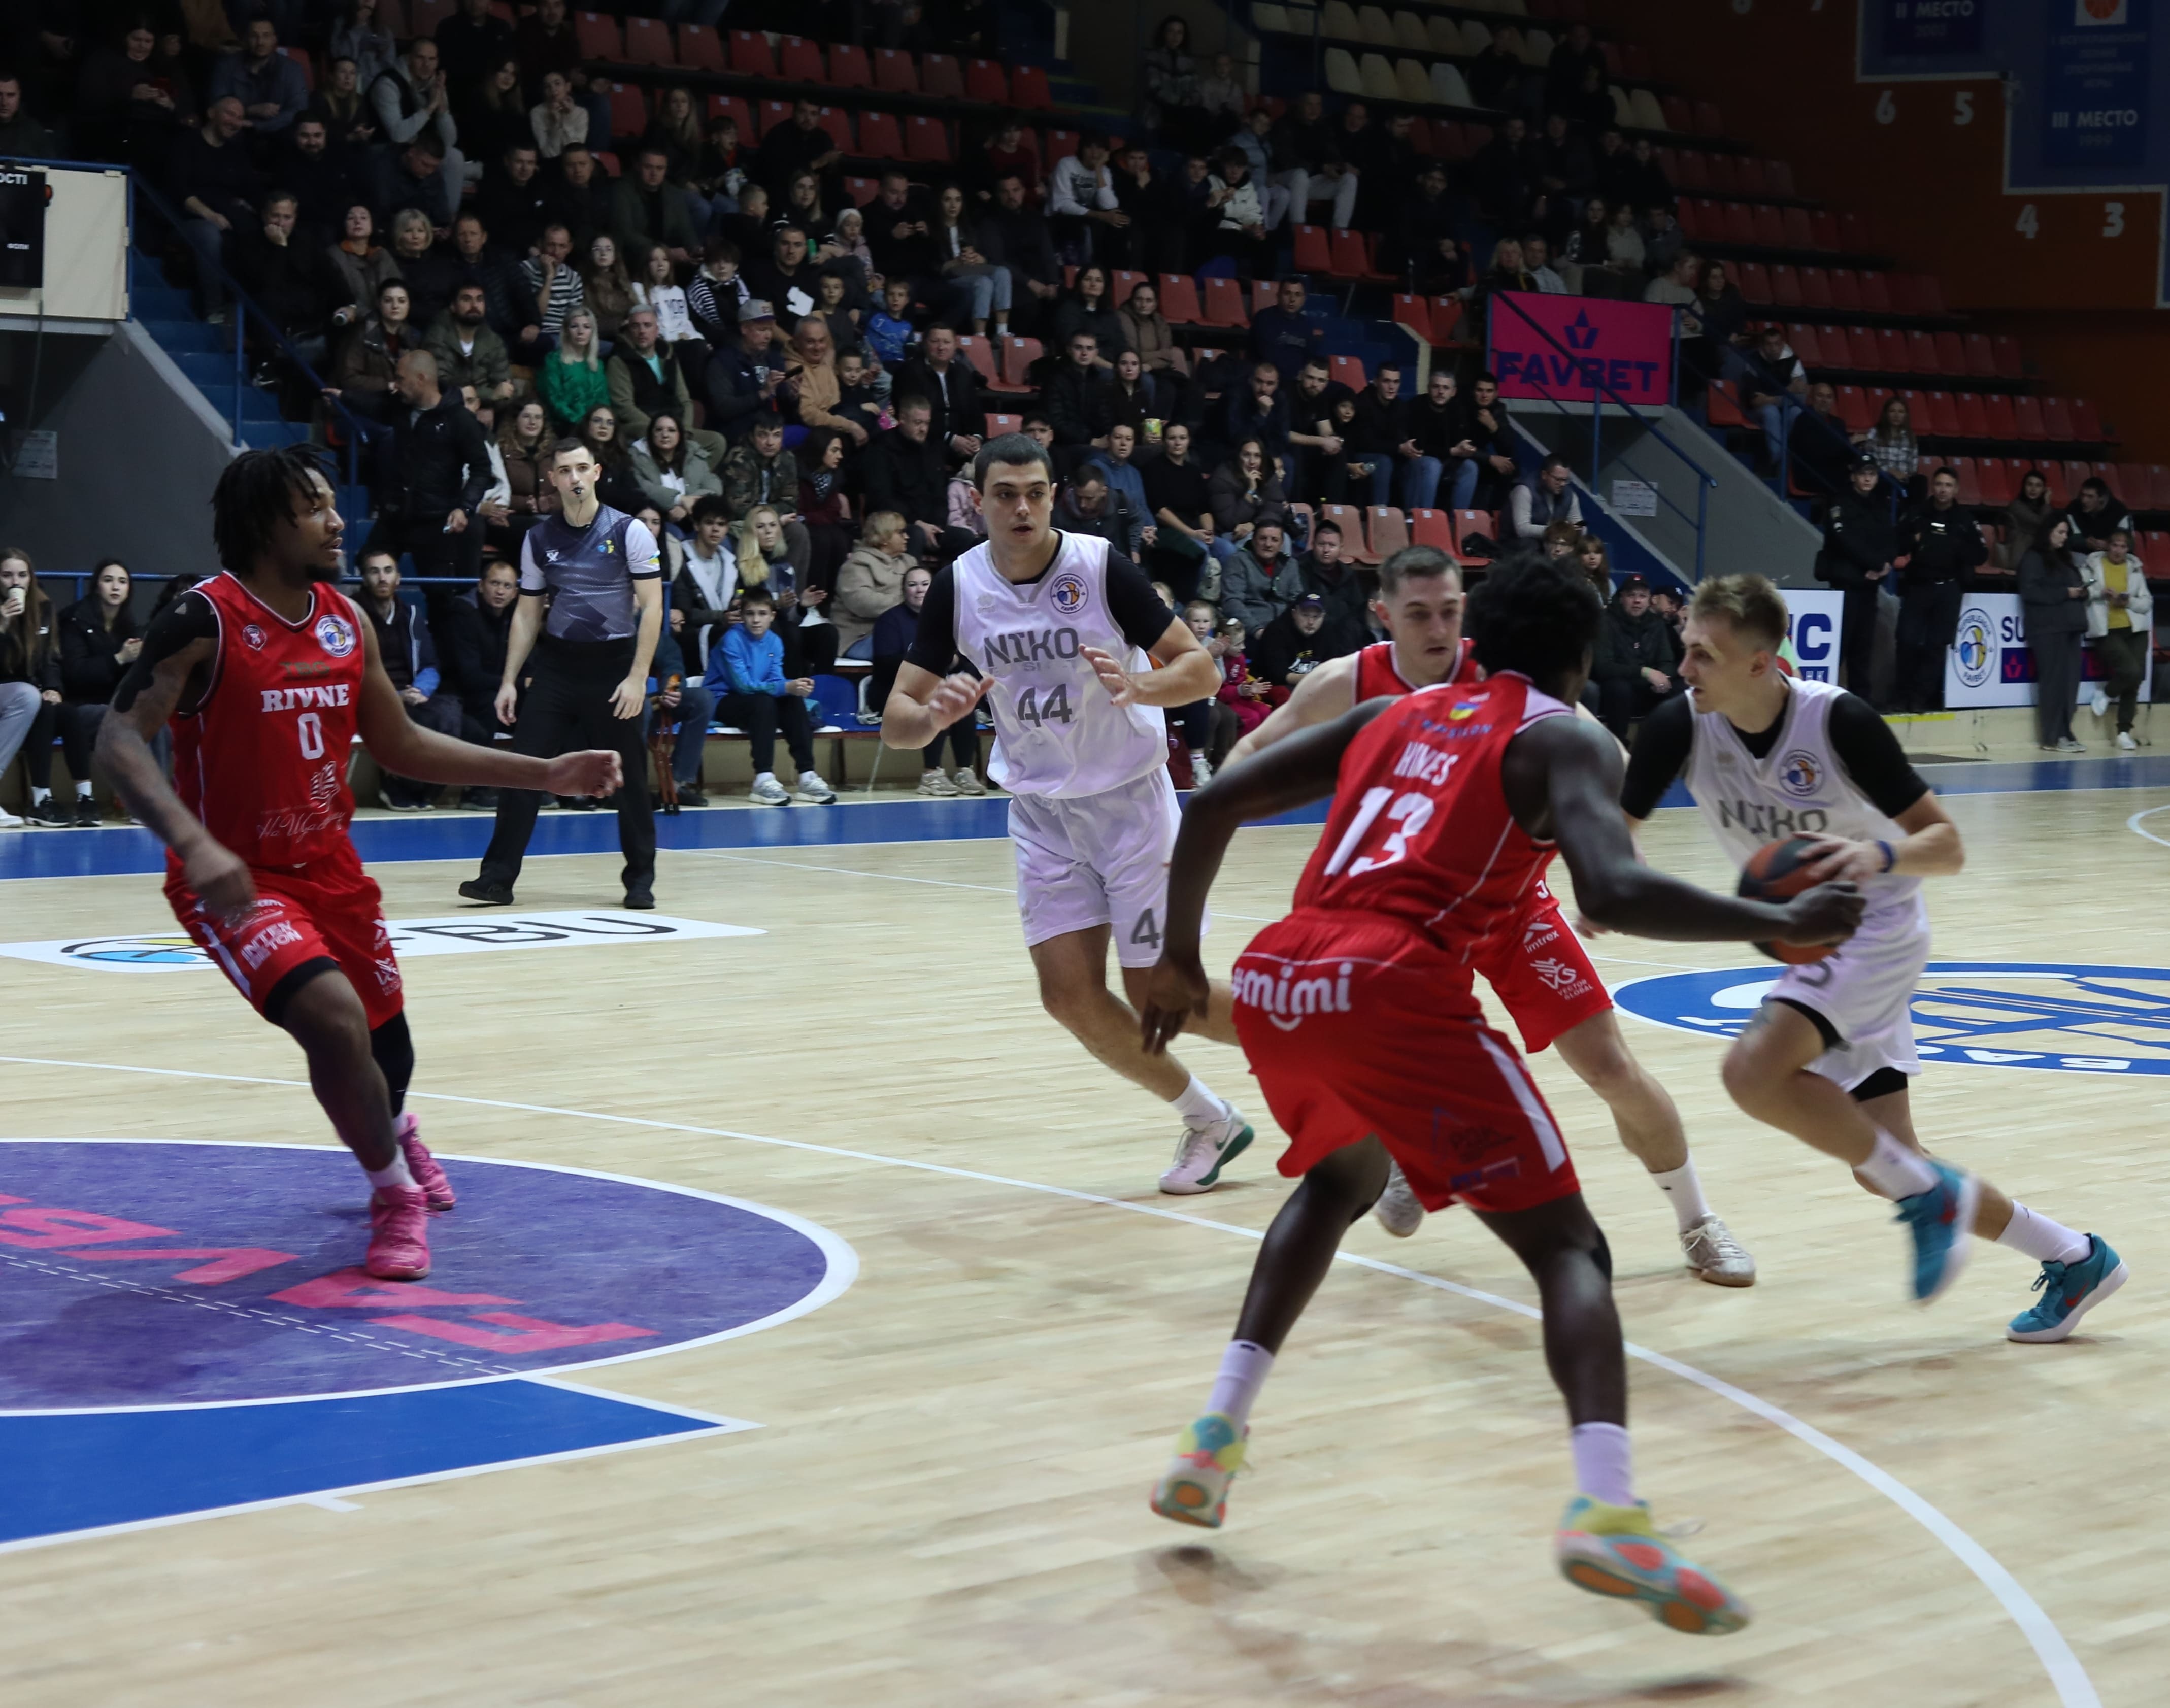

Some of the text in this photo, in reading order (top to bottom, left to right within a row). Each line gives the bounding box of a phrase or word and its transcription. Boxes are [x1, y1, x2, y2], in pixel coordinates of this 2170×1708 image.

[1915, 0, 1974, 18] МЕСТО
[1875, 90, 1896, 125] 6
[1953, 91, 1974, 125] 5
[2076, 109, 2139, 127] МЕСТО
[2015, 204, 2039, 239] 4
[2102, 202, 2125, 238] 3
[1498, 351, 1659, 391] FAVBET
[984, 627, 1079, 667] NIKO
[260, 684, 350, 713] RIVNE
[1018, 683, 1073, 727] 44
[297, 713, 325, 760] 0
[1324, 786, 1435, 877] 13
[1718, 799, 1827, 838] NIKO
[392, 917, 678, 950] BU
[1524, 930, 1560, 953] imtrex
